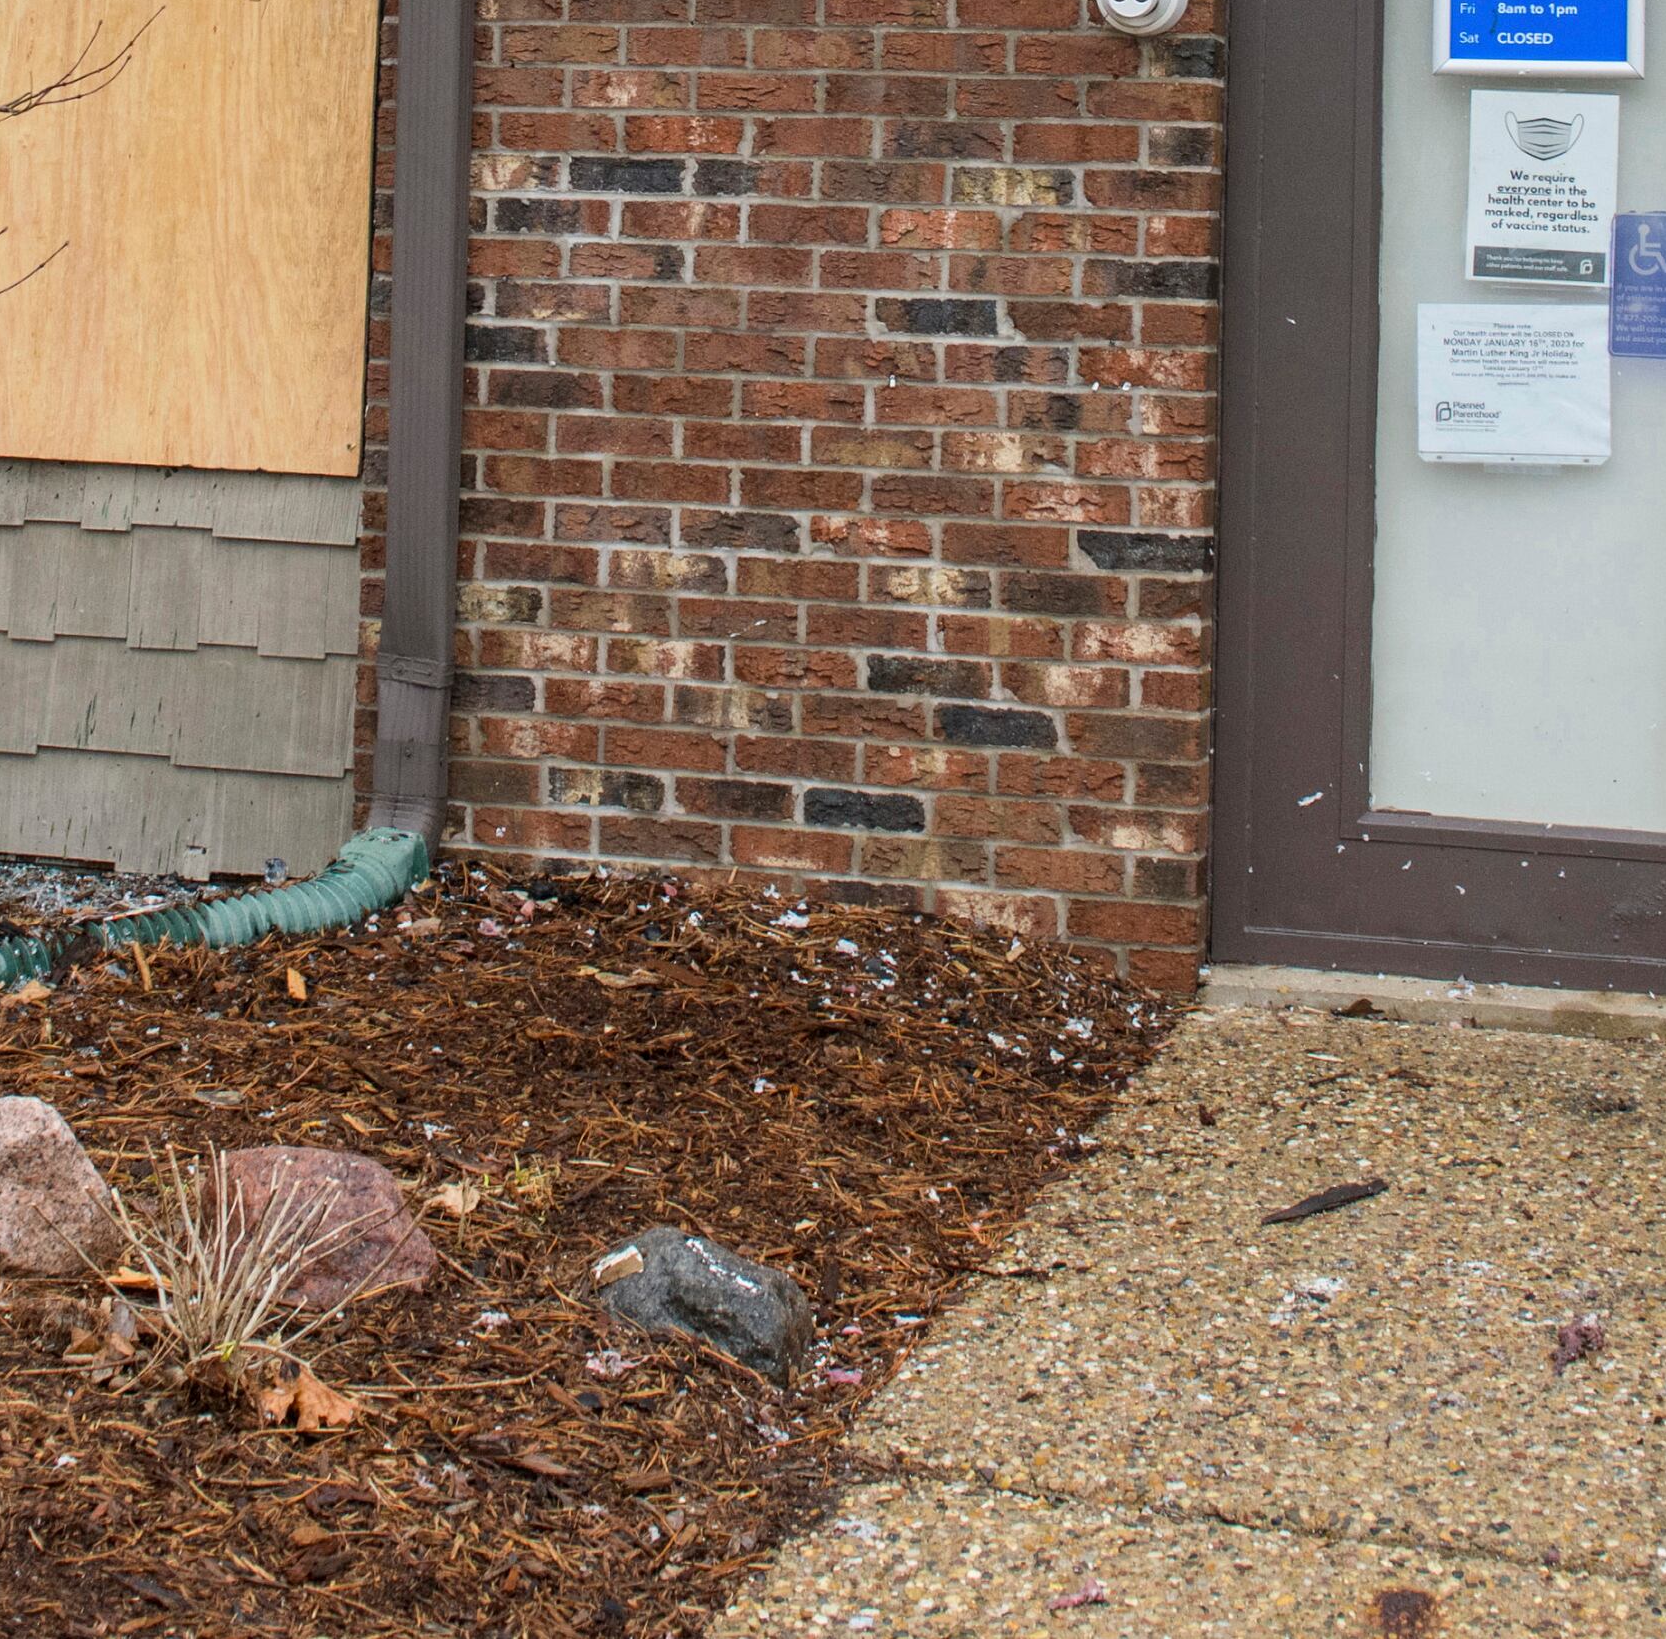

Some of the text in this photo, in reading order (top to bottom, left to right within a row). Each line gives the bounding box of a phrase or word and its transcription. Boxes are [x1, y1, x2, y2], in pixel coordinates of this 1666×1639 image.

[1460, 3, 1578, 18] Fri 8am to 1pm
[1459, 32, 1553, 45] Sat CLOSED
[1510, 170, 1575, 184] We require
[1497, 185, 1587, 196] everyone in the
[1488, 194, 1596, 209] health center to be
[1484, 207, 1599, 222] masked, regardless
[1491, 218, 1590, 234] of vaccine status.
[1453, 329, 1466, 337] Our
[1467, 329, 1487, 337] health
[1443, 338, 1482, 347] MONDAY
[1484, 338, 1526, 347] JANUARY
[1550, 340, 1572, 348] 2023
[1573, 340, 1585, 348] for
[1451, 348, 1478, 357] Martin
[1480, 349, 1507, 357] Luther
[1509, 349, 1529, 359] King
[1531, 349, 1540, 358] Jr
[1453, 402, 1485, 410] Planned
[1453, 410, 1500, 418] Parenthood
